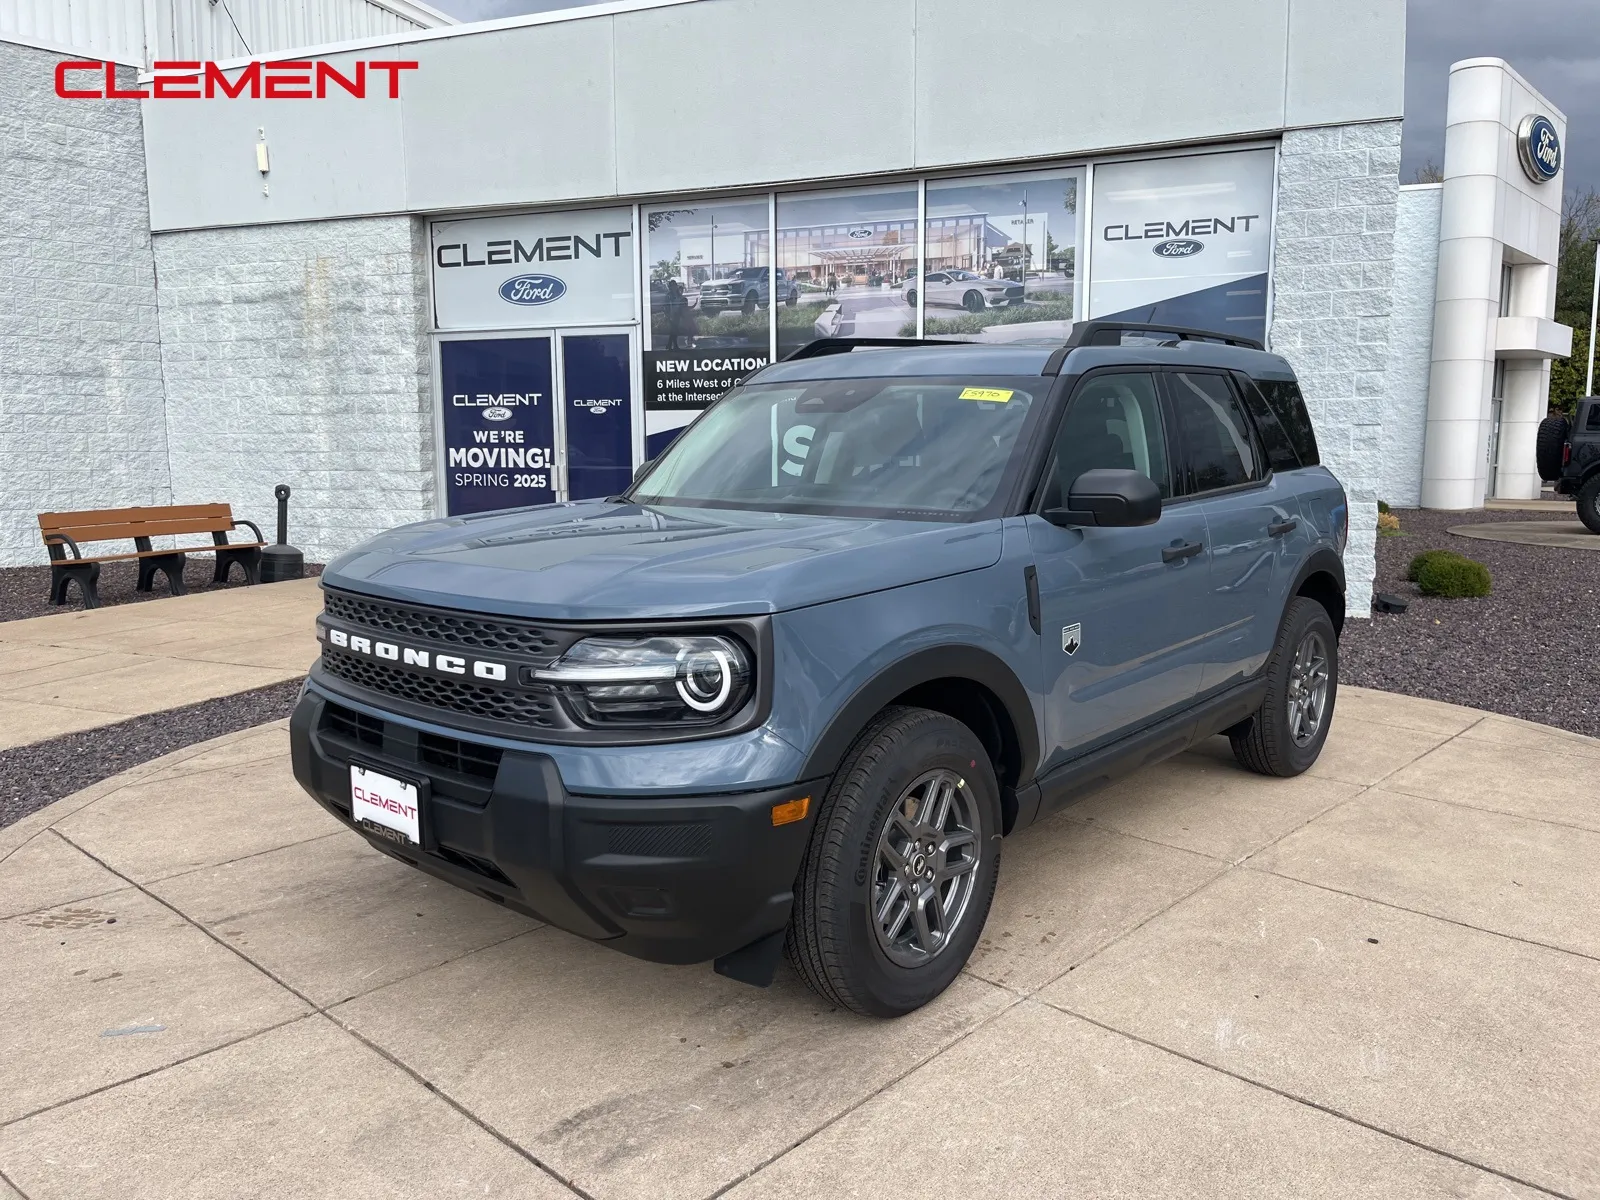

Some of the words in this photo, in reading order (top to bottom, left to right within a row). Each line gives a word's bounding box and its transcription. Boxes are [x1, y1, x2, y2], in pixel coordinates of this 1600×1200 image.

[1104, 215, 1259, 241] CLEMENT
[437, 231, 632, 268] CLEMENT
[656, 360, 690, 373] NEW
[693, 357, 767, 372] LOCATION
[657, 379, 664, 389] 6
[666, 379, 691, 389] Miles
[693, 378, 719, 388] West
[721, 377, 732, 388] of
[453, 393, 543, 407] CLEMENT
[573, 399, 623, 407] CLEMENT
[657, 392, 666, 401] at
[668, 391, 683, 401] the
[685, 390, 724, 401] Intersec
[473, 430, 525, 444] WE'RE
[449, 447, 551, 469] MOVING!
[455, 473, 510, 488] SPRING
[513, 474, 547, 488] 2025
[329, 628, 508, 682] BRONCO
[353, 786, 417, 820] CLEMENT
[362, 819, 407, 845] CLEMENT
